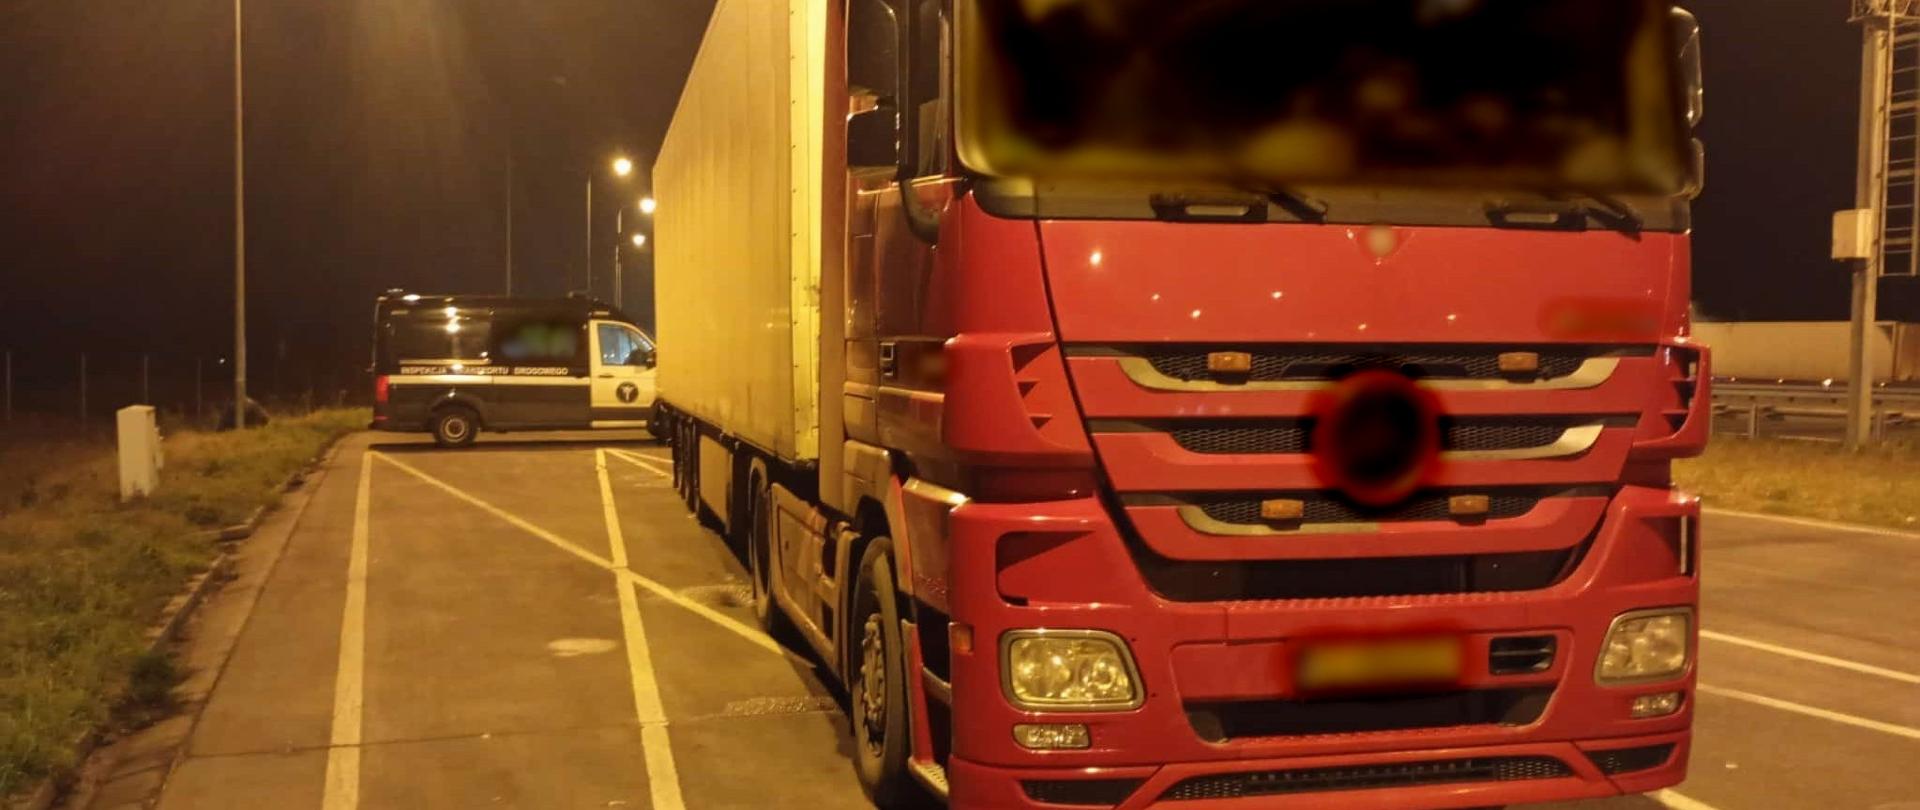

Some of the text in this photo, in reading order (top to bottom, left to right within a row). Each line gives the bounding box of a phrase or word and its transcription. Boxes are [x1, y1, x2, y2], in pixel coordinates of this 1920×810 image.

[401, 366, 569, 376] INSPEKCJA ANSPORTU DROGOWEGO
